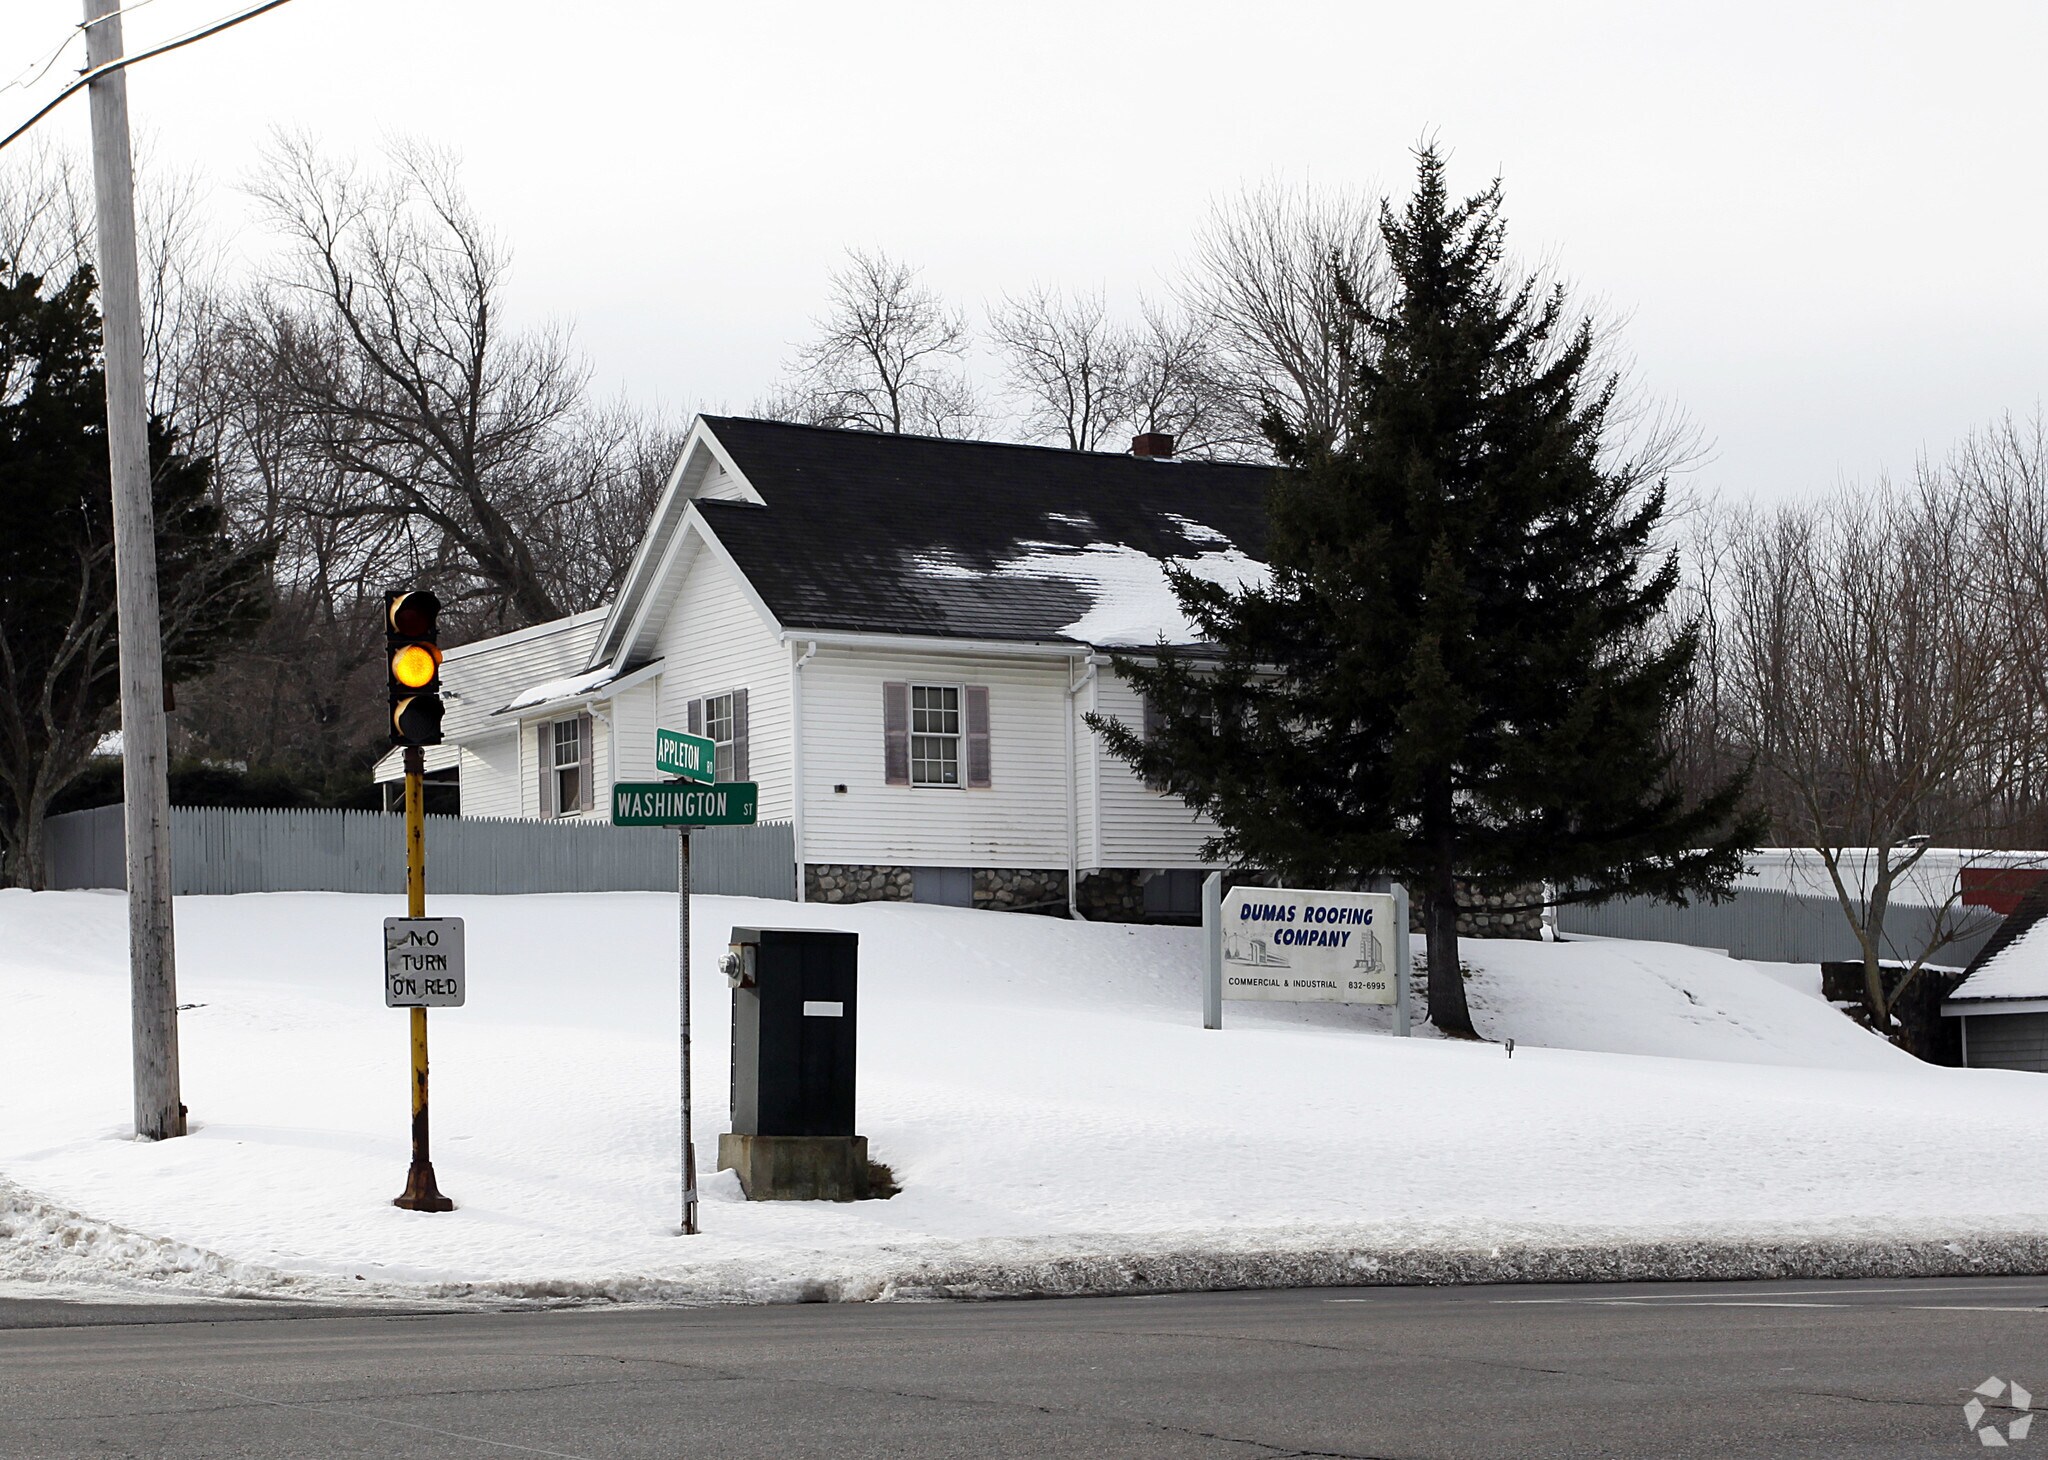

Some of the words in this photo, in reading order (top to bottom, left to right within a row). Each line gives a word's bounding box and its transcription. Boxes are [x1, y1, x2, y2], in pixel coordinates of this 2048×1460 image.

[658, 738, 700, 771] APPLETON
[618, 792, 727, 817] WASHINGTON
[743, 803, 753, 816] ST
[1240, 903, 1296, 922] DUMAS
[1303, 906, 1373, 925] ROOFING
[410, 930, 439, 946] NO
[1274, 929, 1351, 947] COMPANY
[402, 954, 447, 970] TURN
[393, 979, 416, 995] ON
[425, 979, 457, 995] RED
[1229, 977, 1280, 987] COMMERCIAL
[1284, 979, 1289, 987] &
[1293, 980, 1337, 988] INDUSTRIAL
[1348, 981, 1386, 990] 832-6995
